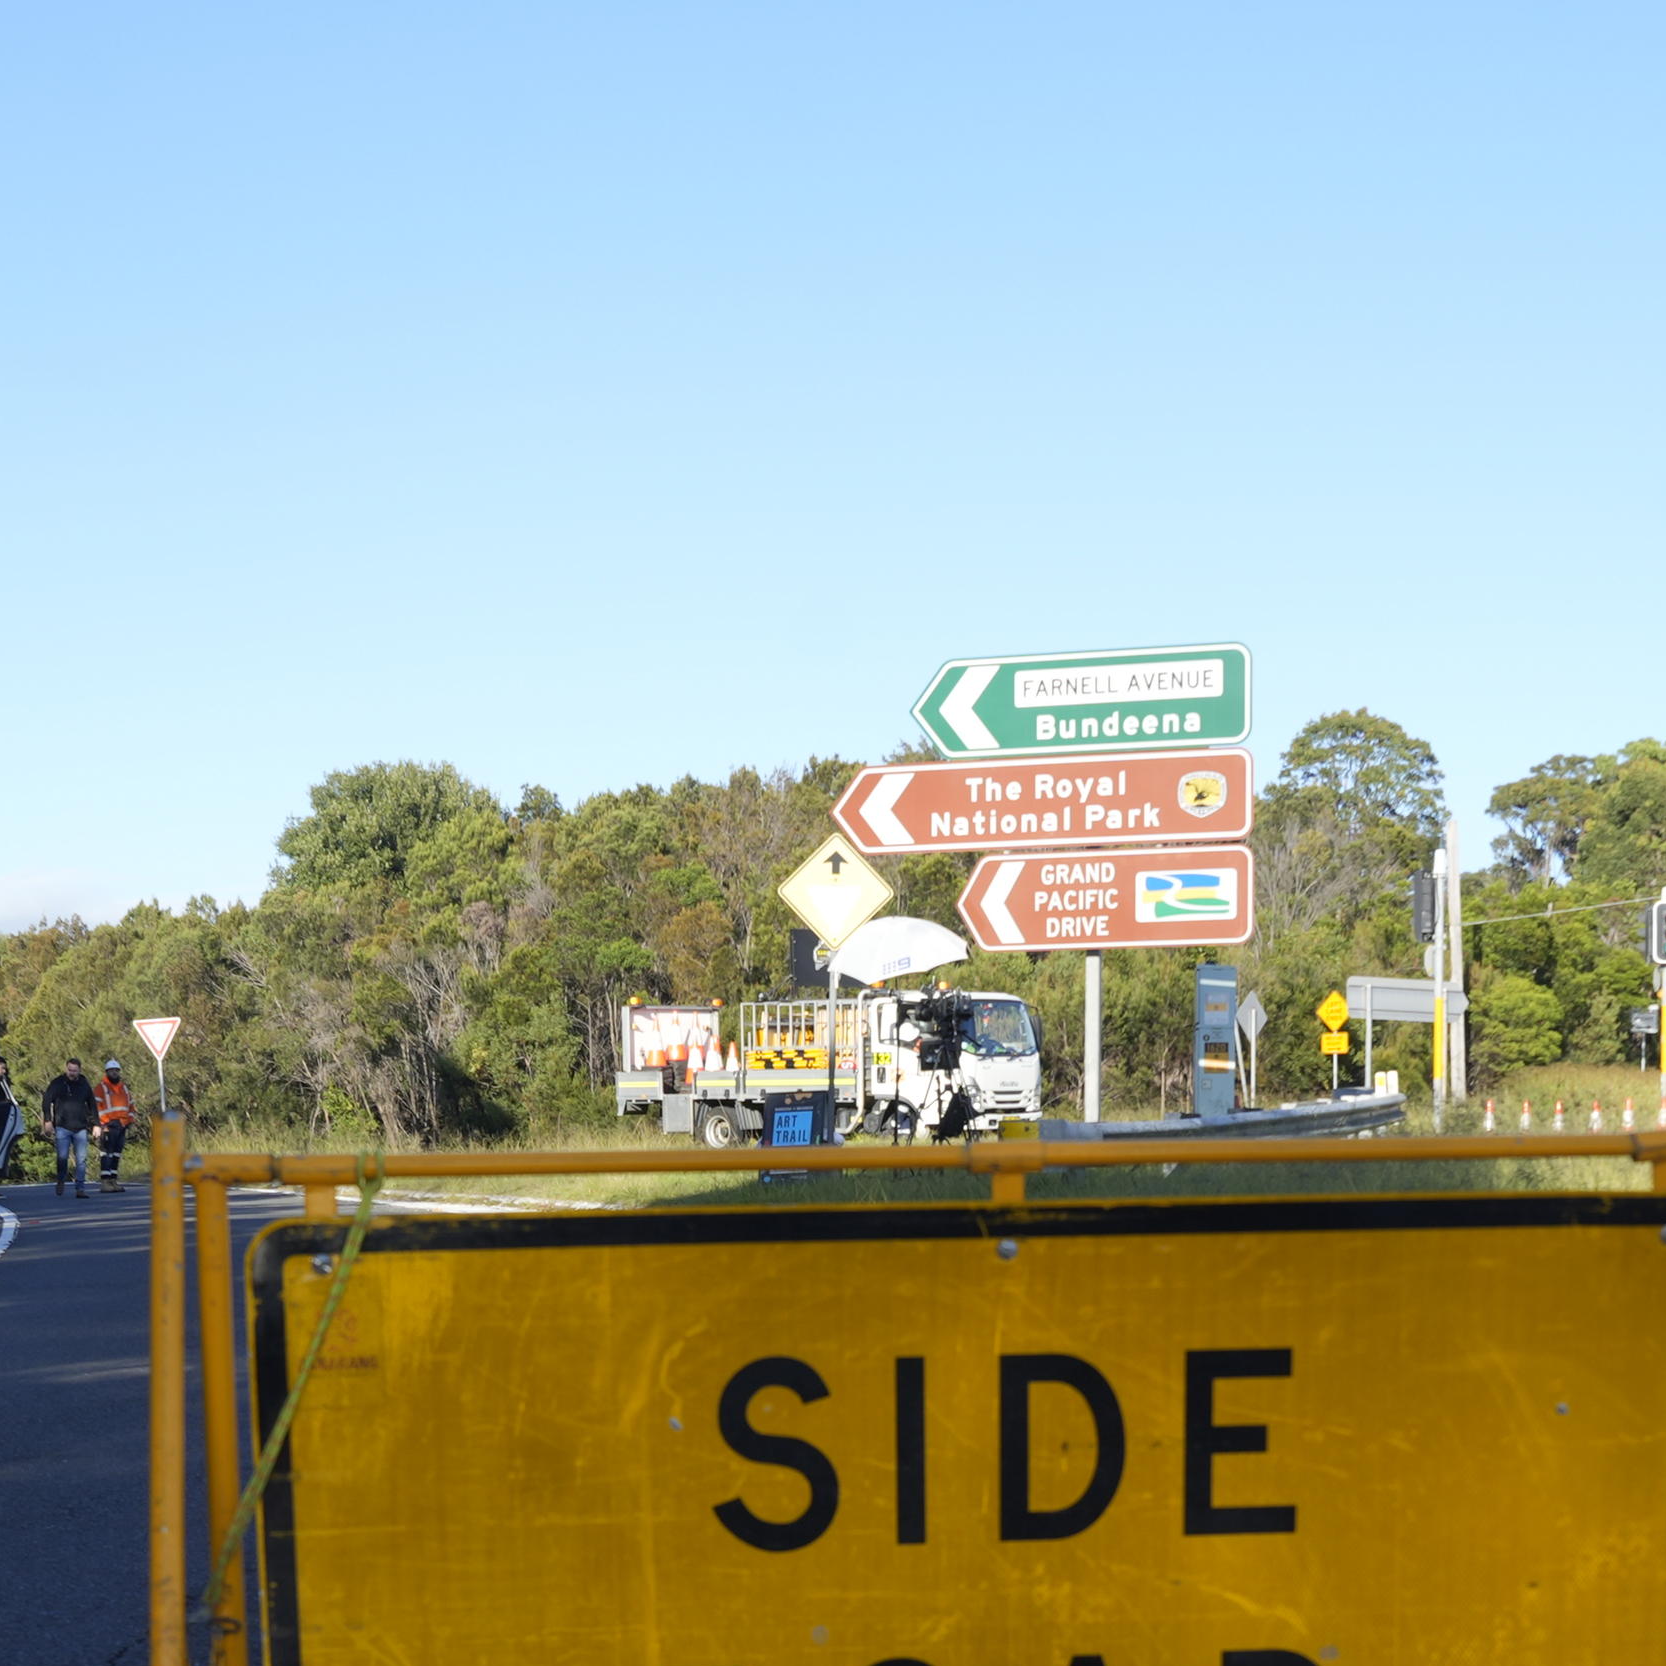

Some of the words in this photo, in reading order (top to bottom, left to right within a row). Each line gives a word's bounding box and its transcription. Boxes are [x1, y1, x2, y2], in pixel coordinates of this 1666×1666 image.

[1023, 675, 1118, 698] FARNELL
[1127, 669, 1214, 692] AVENUE
[1036, 710, 1202, 741] Bundeena
[965, 777, 1022, 802] The
[1034, 770, 1126, 803] Royal
[930, 805, 1071, 837] National
[1085, 802, 1160, 830] Park
[1040, 861, 1116, 886] GRAND
[1034, 888, 1119, 912] PACIFIC
[1046, 915, 1110, 939] DRIVE
[776, 1114, 798, 1129] ART
[775, 1130, 808, 1144] TRAIL
[713, 1348, 1299, 1552] SIDE
